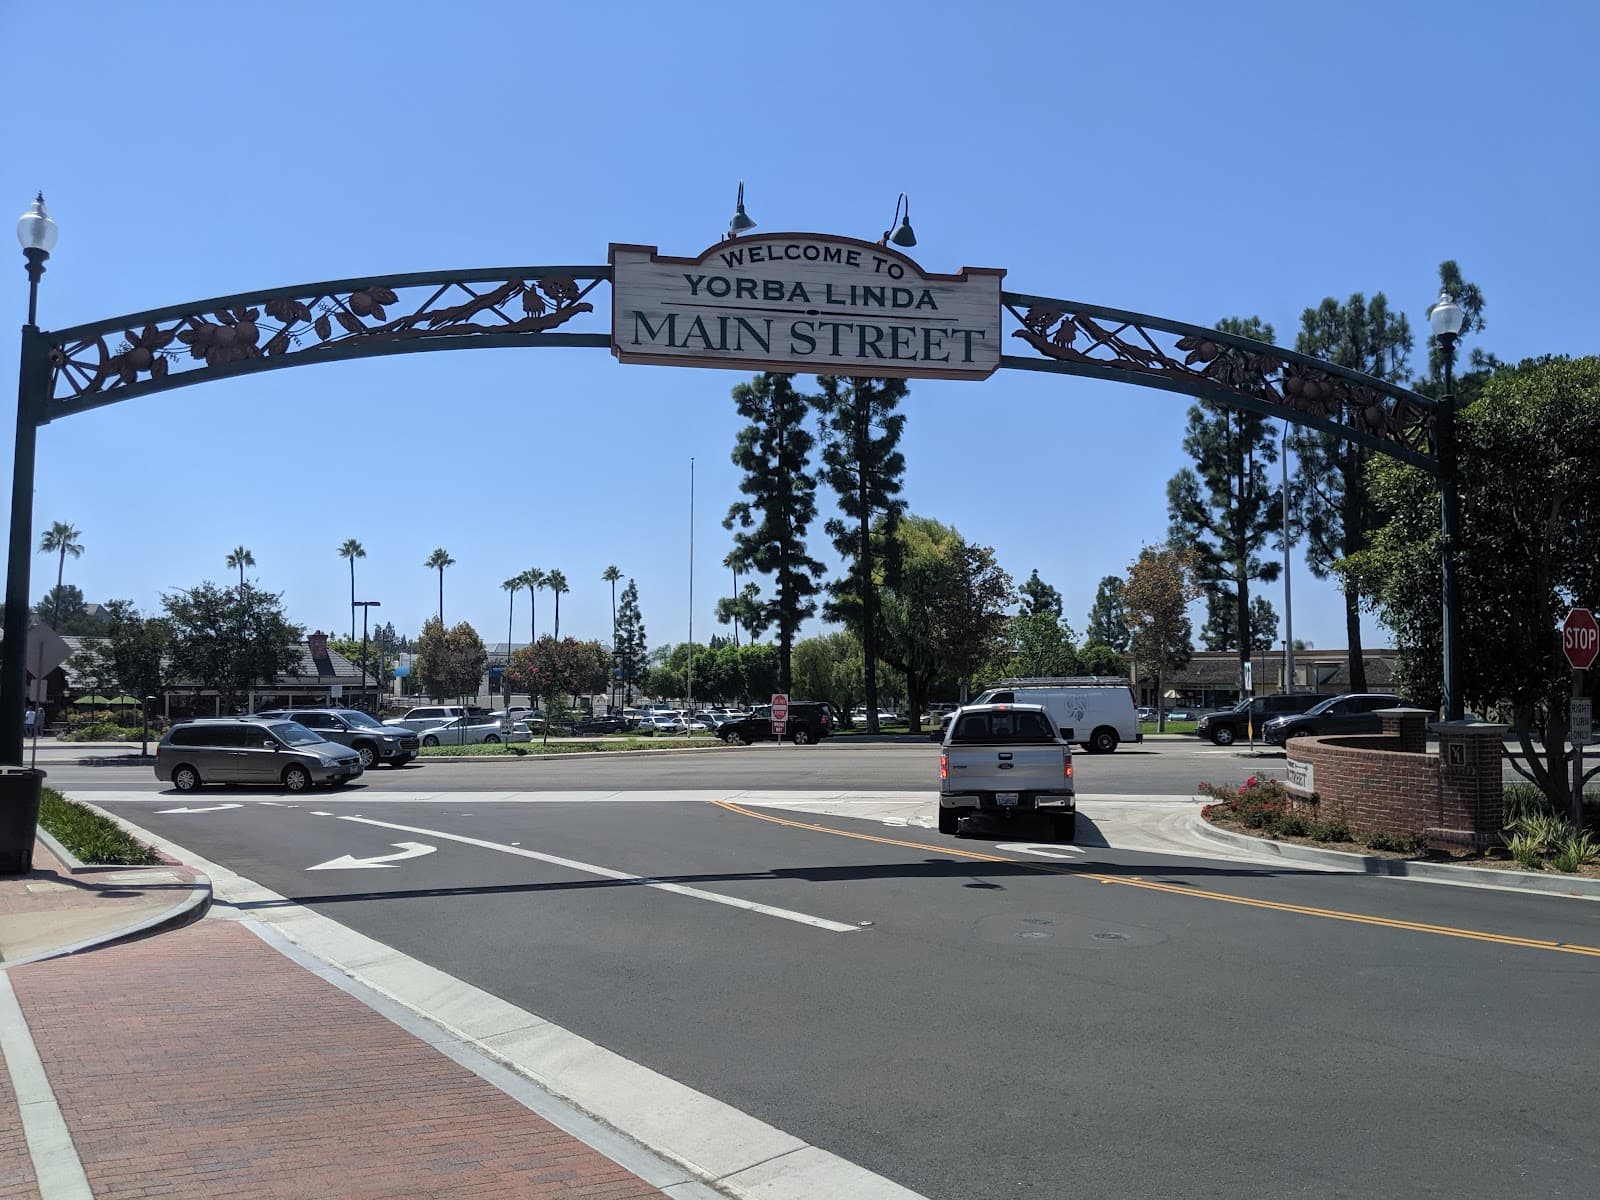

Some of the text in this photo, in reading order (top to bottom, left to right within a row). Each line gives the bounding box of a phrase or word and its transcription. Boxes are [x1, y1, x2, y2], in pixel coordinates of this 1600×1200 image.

[720, 244, 905, 280] WELCOME TO
[683, 274, 938, 310] YORBA LINDA
[631, 310, 986, 363] MAIN STREET
[1566, 627, 1596, 649] STOP
[1571, 703, 1592, 713] RIGHT
[1573, 716, 1591, 726] TURN
[1573, 730, 1591, 739] ONLY
